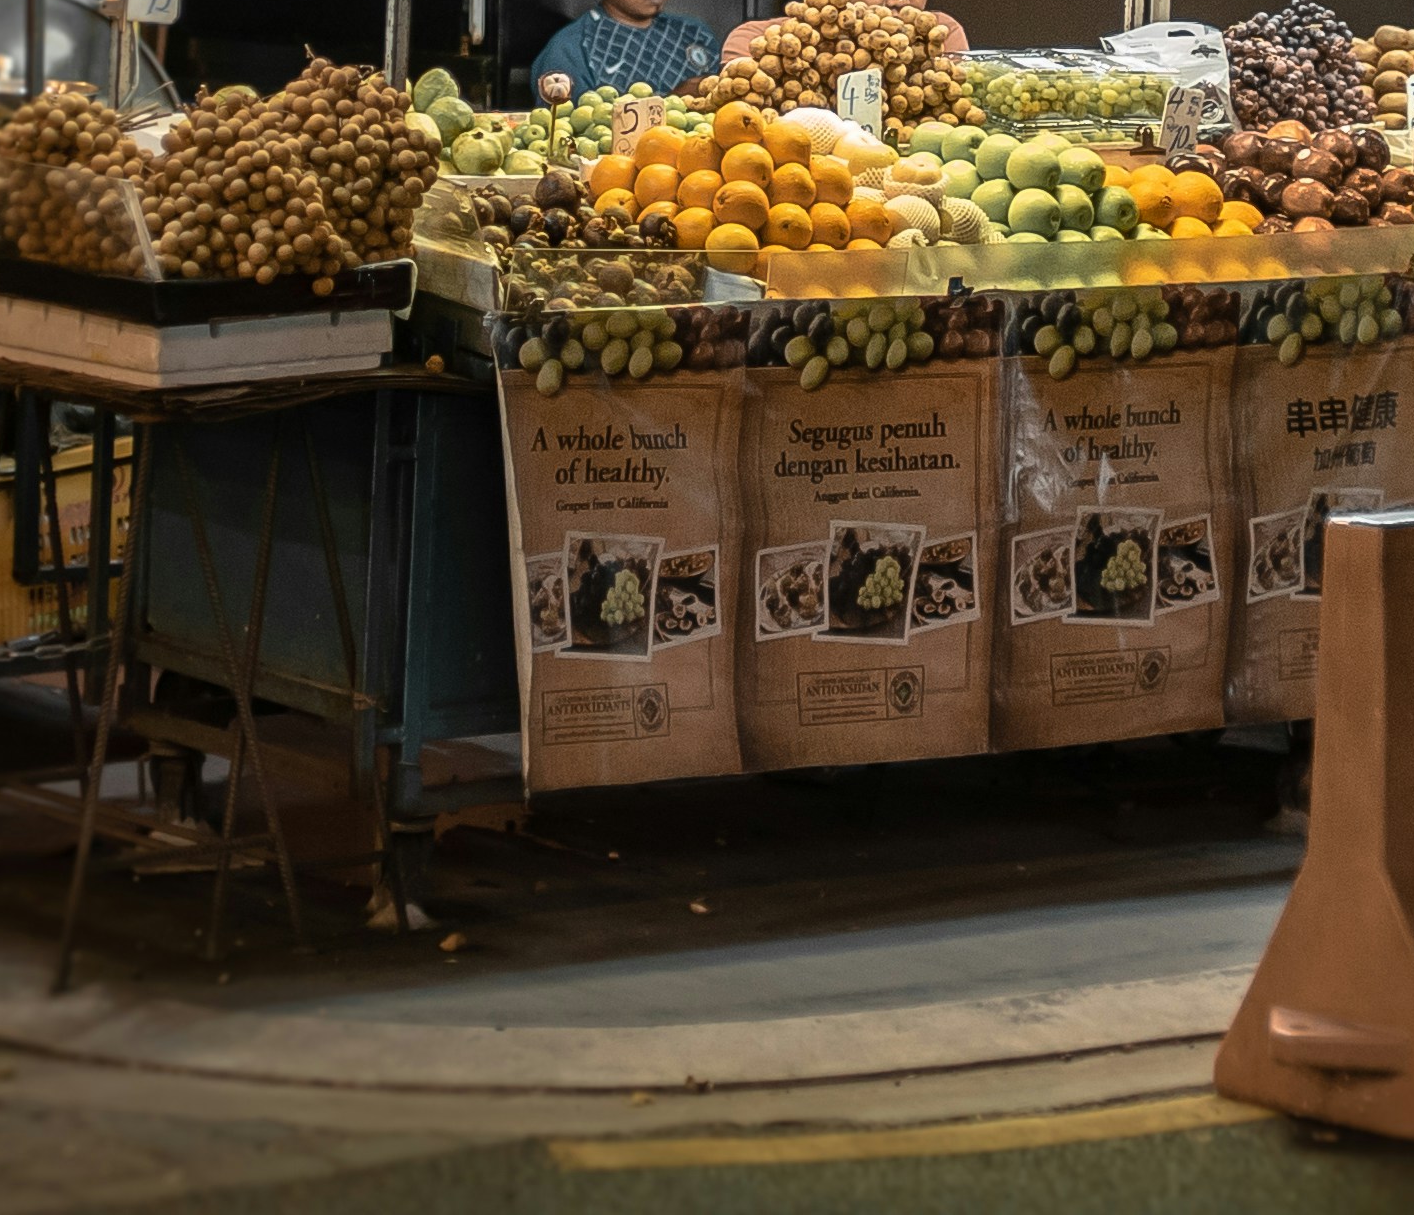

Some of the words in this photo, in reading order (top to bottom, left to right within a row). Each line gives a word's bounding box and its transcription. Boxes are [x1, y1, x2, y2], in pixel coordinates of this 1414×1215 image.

[842, 75, 859, 115] 4
[1168, 87, 1184, 114] 4
[620, 102, 638, 135] 5
[1043, 407, 1057, 432] A
[1064, 404, 1121, 431] whole
[1126, 400, 1181, 427] bunch
[1287, 389, 1399, 438] 串串健康
[531, 426, 548, 451] A
[556, 424, 624, 451] whole
[629, 423, 687, 450] bunch
[788, 419, 874, 451] Segugus
[880, 412, 947, 448] penuh
[774, 451, 848, 484] dengan
[855, 446, 960, 473] kesihatan.
[1064, 436, 1085, 462] of
[1088, 434, 1158, 465] healthy.
[555, 457, 581, 484] of
[585, 457, 670, 490] healthy.
[556, 499, 589, 514] Grapes
[592, 497, 614, 510] from
